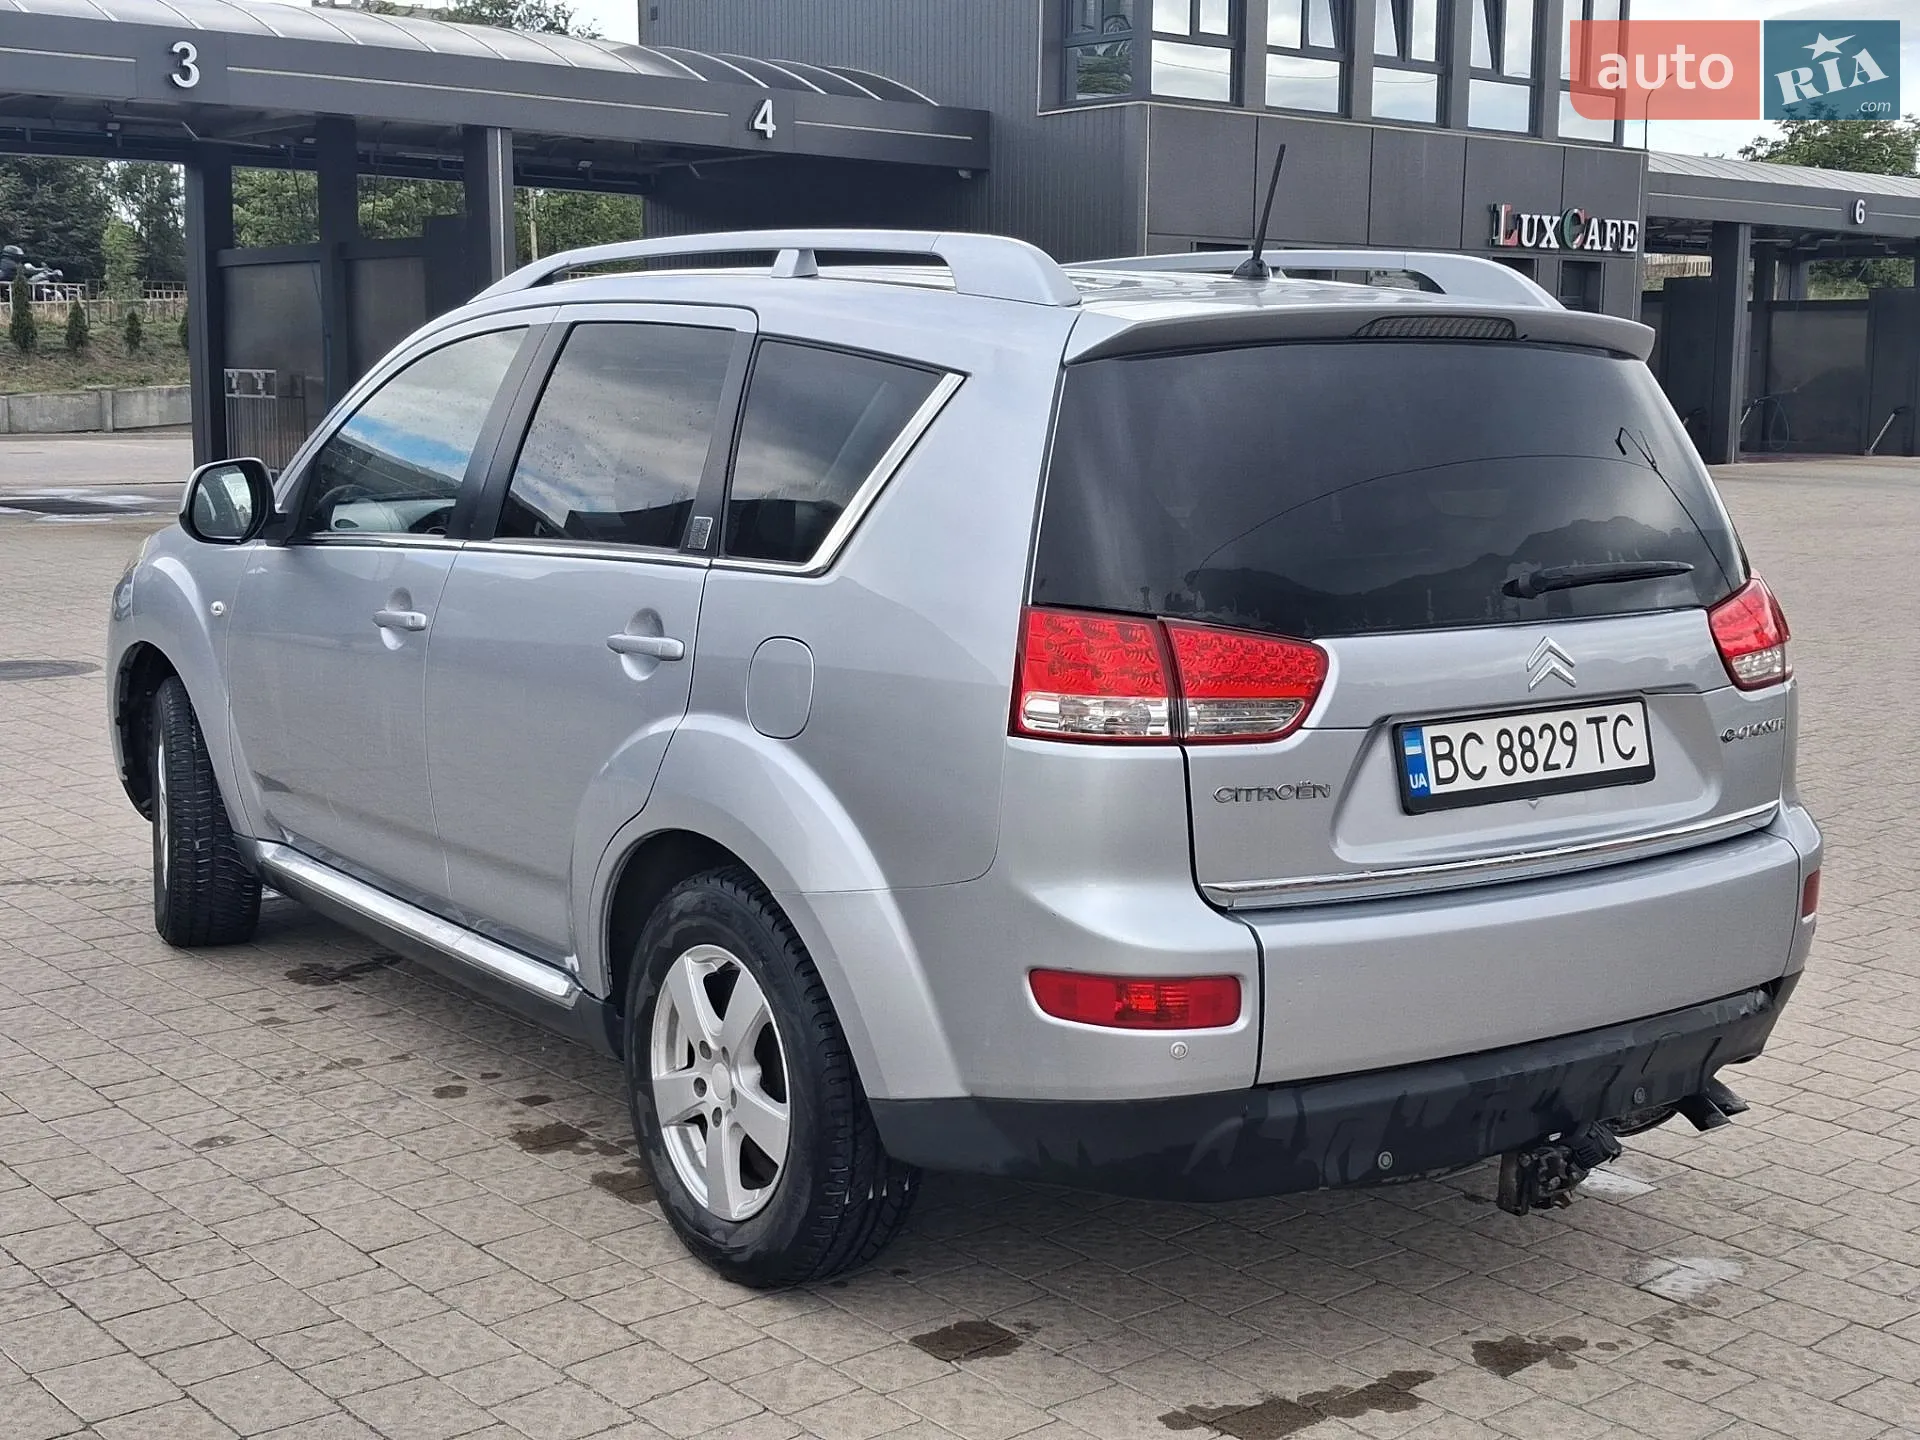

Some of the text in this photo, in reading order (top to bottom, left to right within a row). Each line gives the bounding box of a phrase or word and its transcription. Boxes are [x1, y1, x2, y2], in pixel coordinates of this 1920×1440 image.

[172, 41, 200, 88] 3
[753, 99, 777, 138] 4
[1855, 199, 1866, 224] 6
[1430, 713, 1637, 786] BC 8829 TC
[1409, 772, 1428, 789] UA
